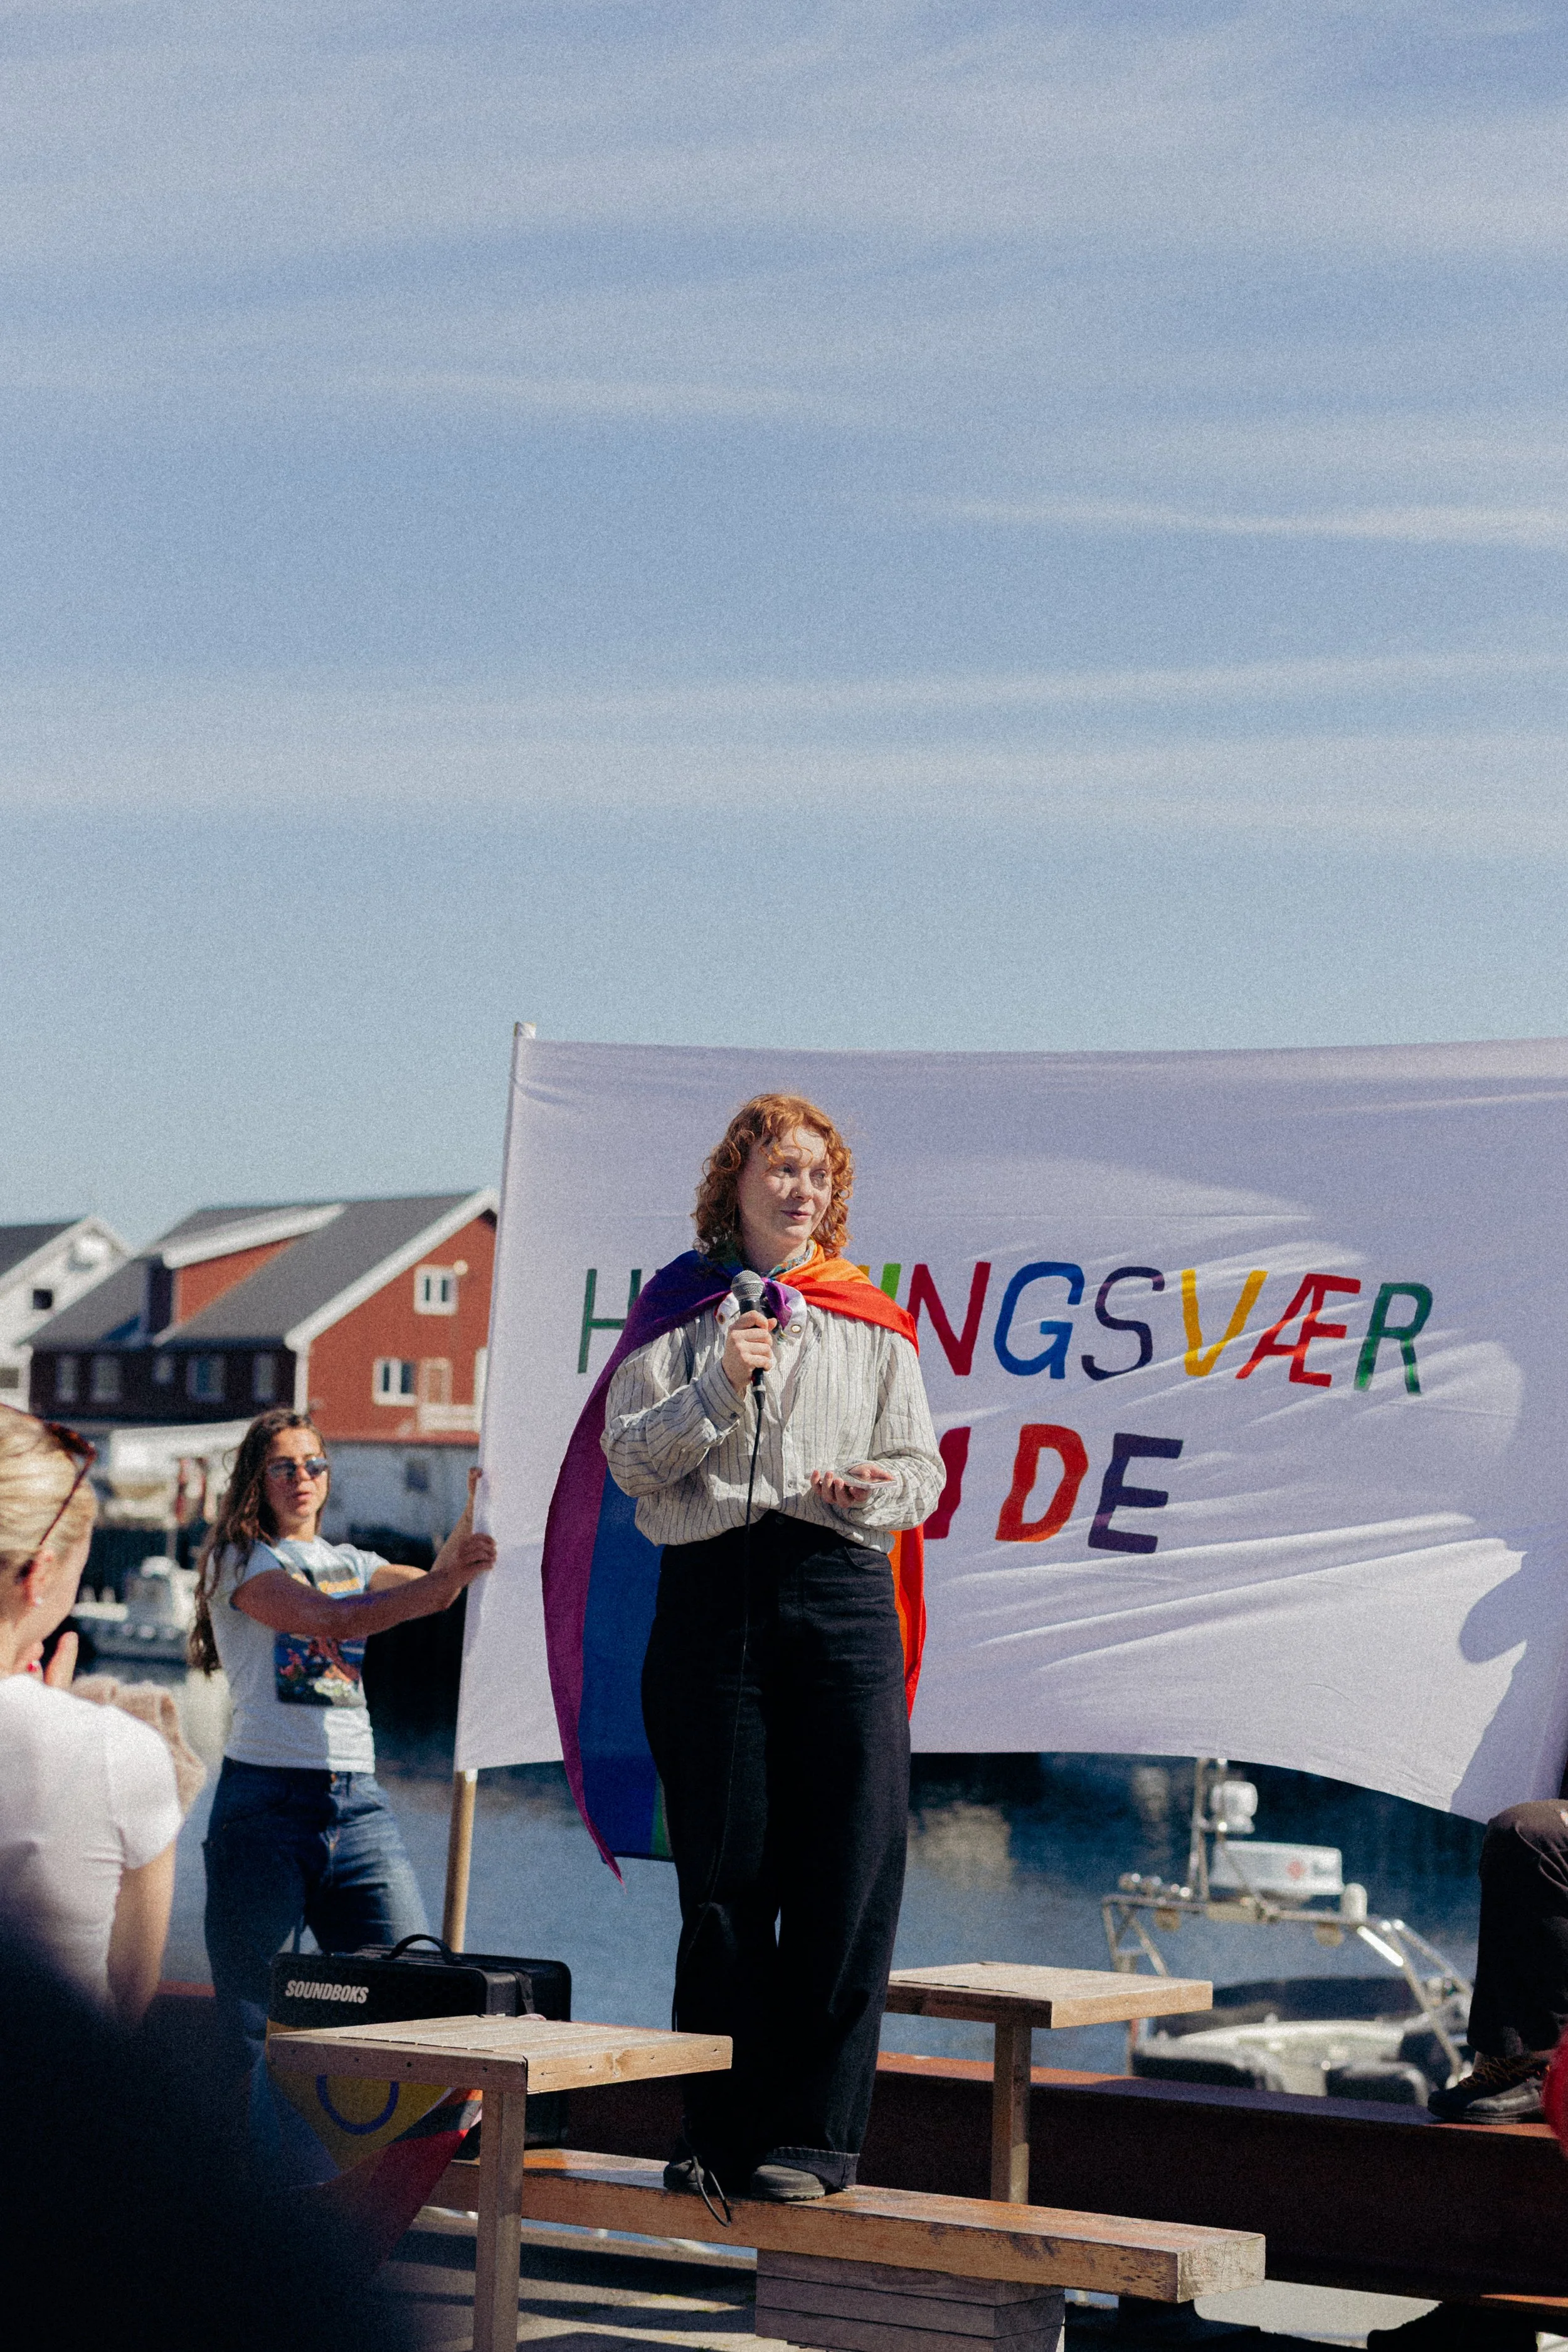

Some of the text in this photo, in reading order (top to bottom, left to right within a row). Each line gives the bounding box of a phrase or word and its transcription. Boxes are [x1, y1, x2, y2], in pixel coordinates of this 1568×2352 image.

[577, 1261, 1434, 1396] HNGSVÆR
[923, 1423, 1184, 1554] IDE
[285, 1979, 369, 2004] SOUNDBOKS
